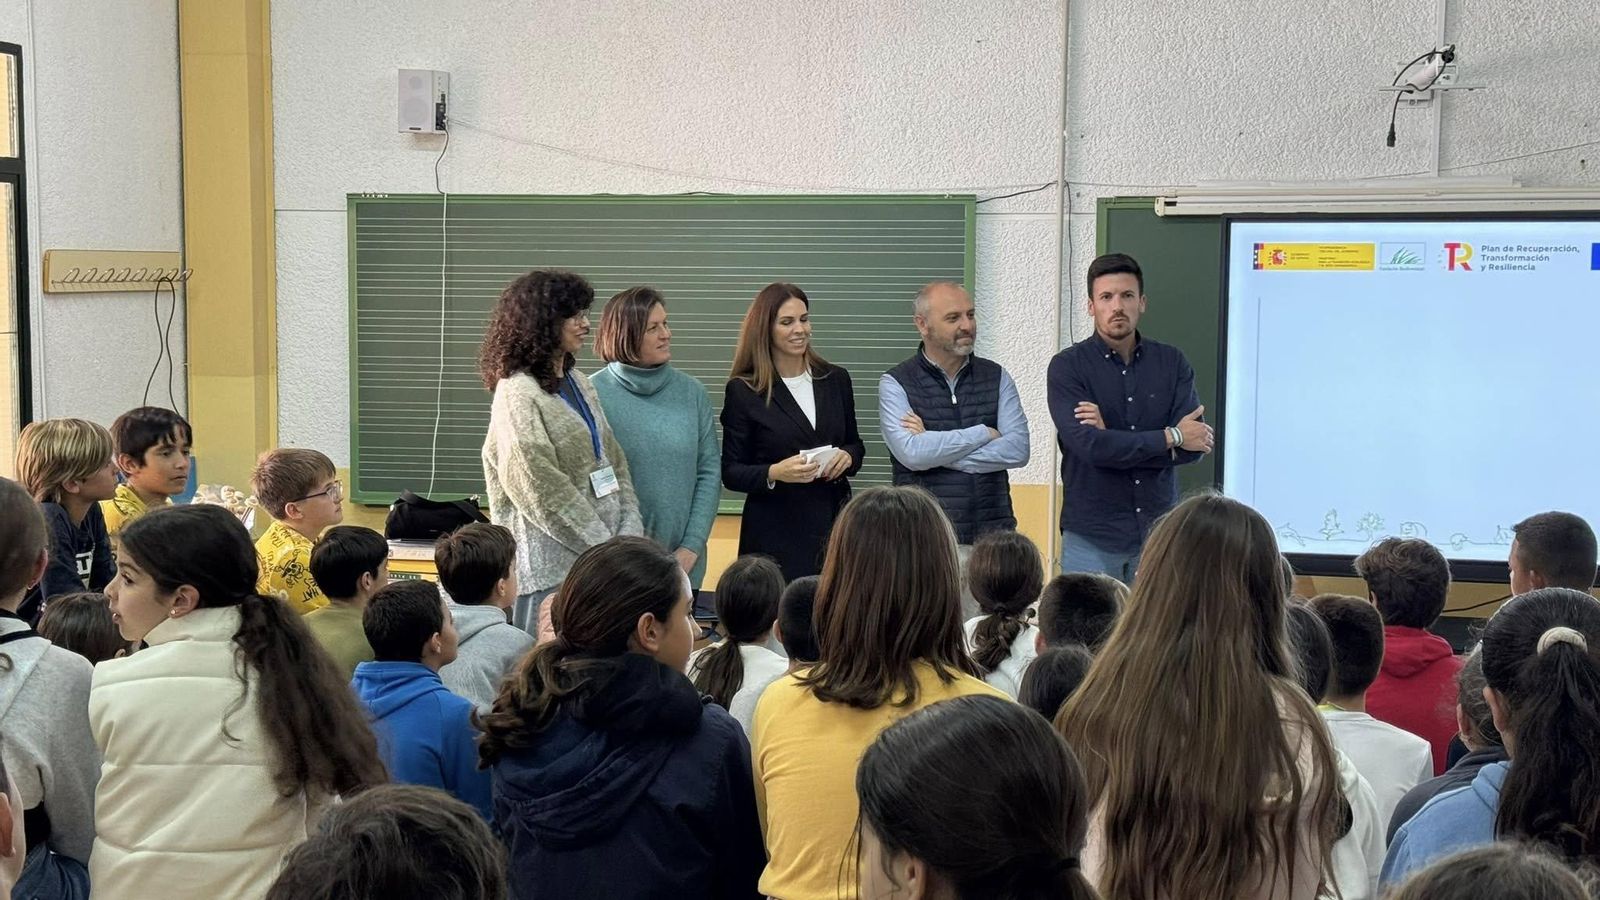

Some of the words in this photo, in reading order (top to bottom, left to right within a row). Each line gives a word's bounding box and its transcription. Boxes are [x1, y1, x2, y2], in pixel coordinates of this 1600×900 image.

[1517, 245, 1580, 254] Recuperación,
[1481, 254, 1550, 262] Transformación
[1481, 264, 1486, 272] y
[1488, 263, 1536, 271] Resiliencia
[302, 588, 320, 603] HAT
